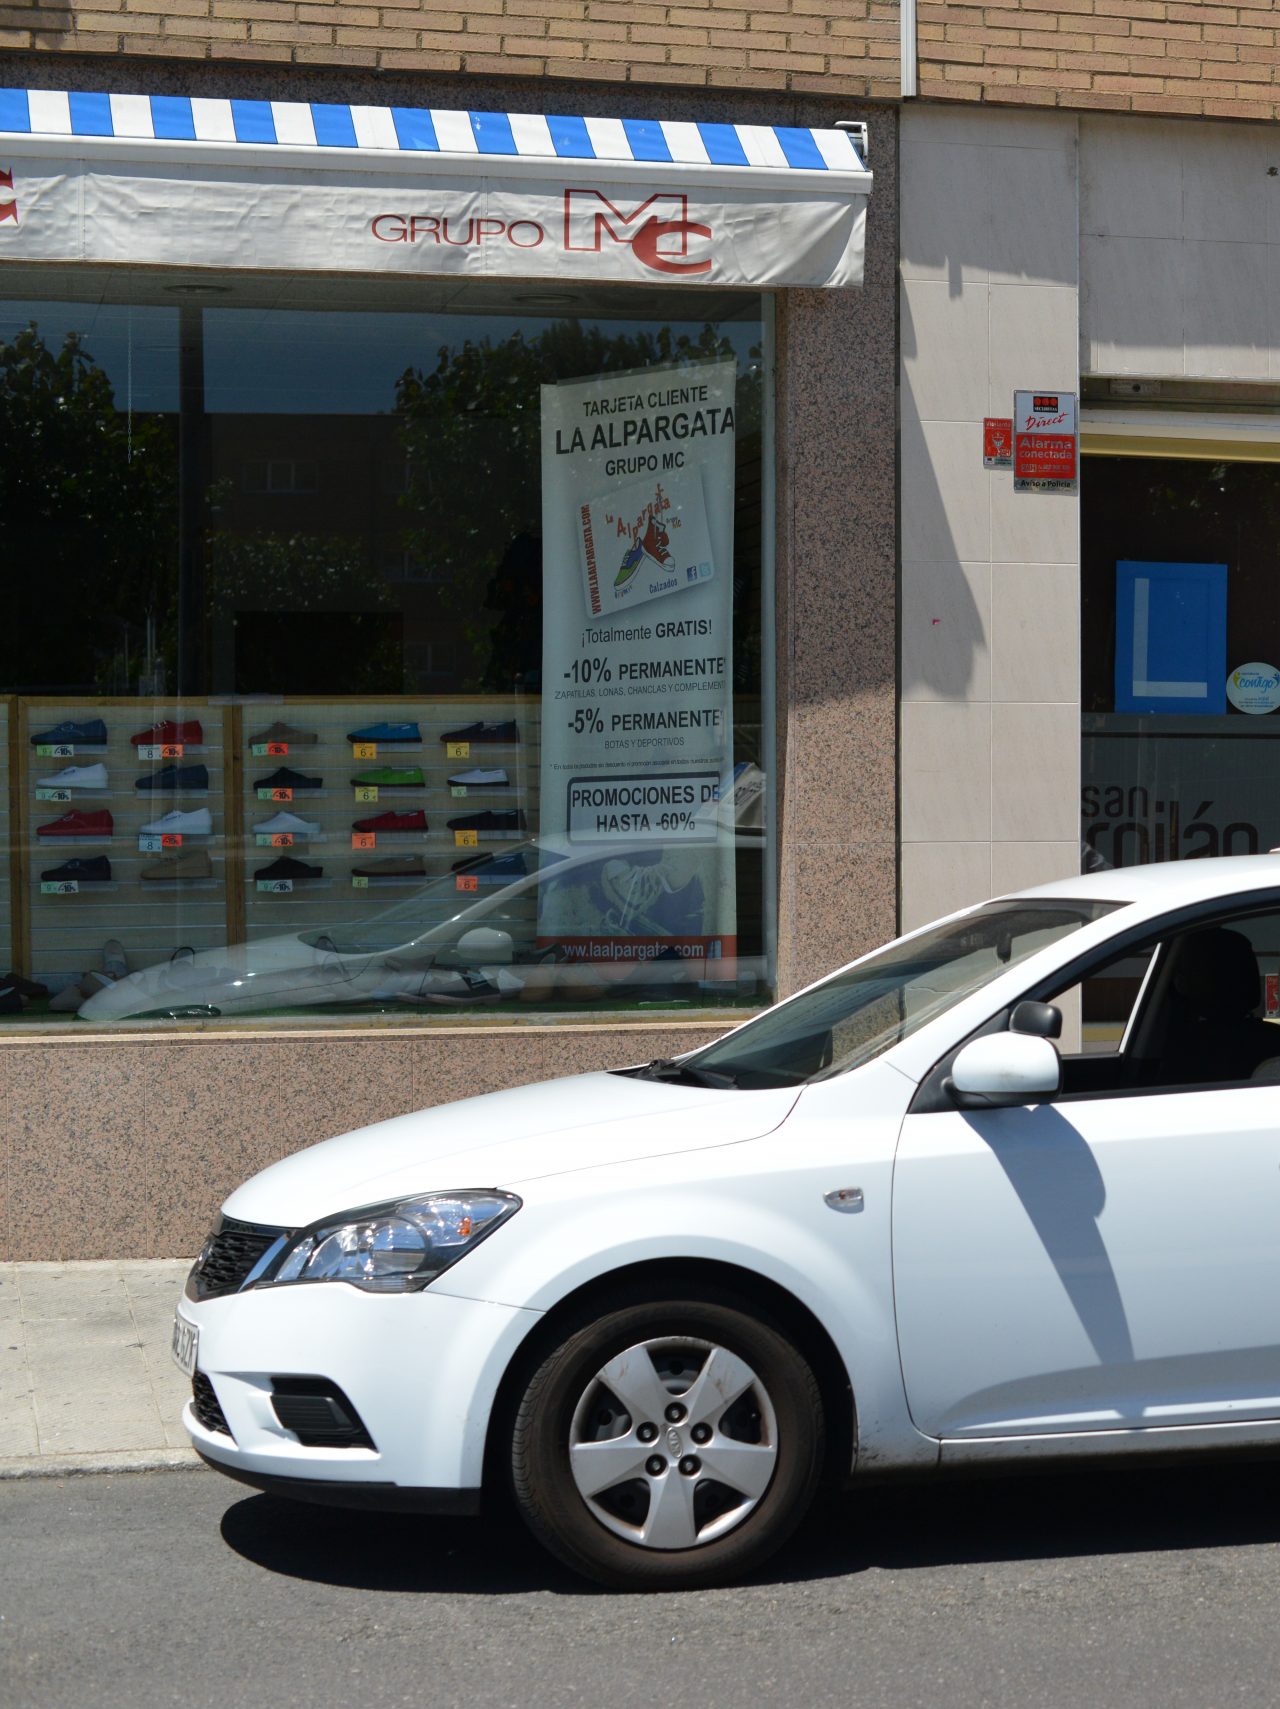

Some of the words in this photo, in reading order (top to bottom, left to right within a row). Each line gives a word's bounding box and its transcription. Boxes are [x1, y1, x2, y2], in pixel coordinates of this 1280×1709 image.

[371, 214, 545, 248] GRUPO
[583, 395, 644, 417] TARJETA
[648, 386, 708, 408] CLIENTE
[556, 427, 586, 455] LA
[591, 407, 735, 450] ALPARGATA
[1025, 412, 1069, 431] Direct
[1020, 451, 1072, 459] conectada
[1021, 437, 1072, 449] Alarma
[605, 455, 658, 476] GRUPO
[662, 451, 685, 470] MC
[655, 619, 712, 639] GRATIS!
[1132, 577, 1208, 698] L
[564, 657, 611, 684] -10%
[628, 684, 667, 696] CHANCLAS
[669, 682, 673, 692] Y
[568, 708, 604, 734] -5%
[604, 739, 630, 750] BOTAS
[631, 738, 637, 748] Y
[638, 737, 685, 749] DEPORTIVOS
[572, 785, 695, 808] PROMOCIONES
[701, 784, 719, 803] DE
[1081, 786, 1148, 818] san
[596, 814, 650, 833] HASTA
[656, 812, 696, 832] -60%
[1086, 801, 1259, 870] roilán
